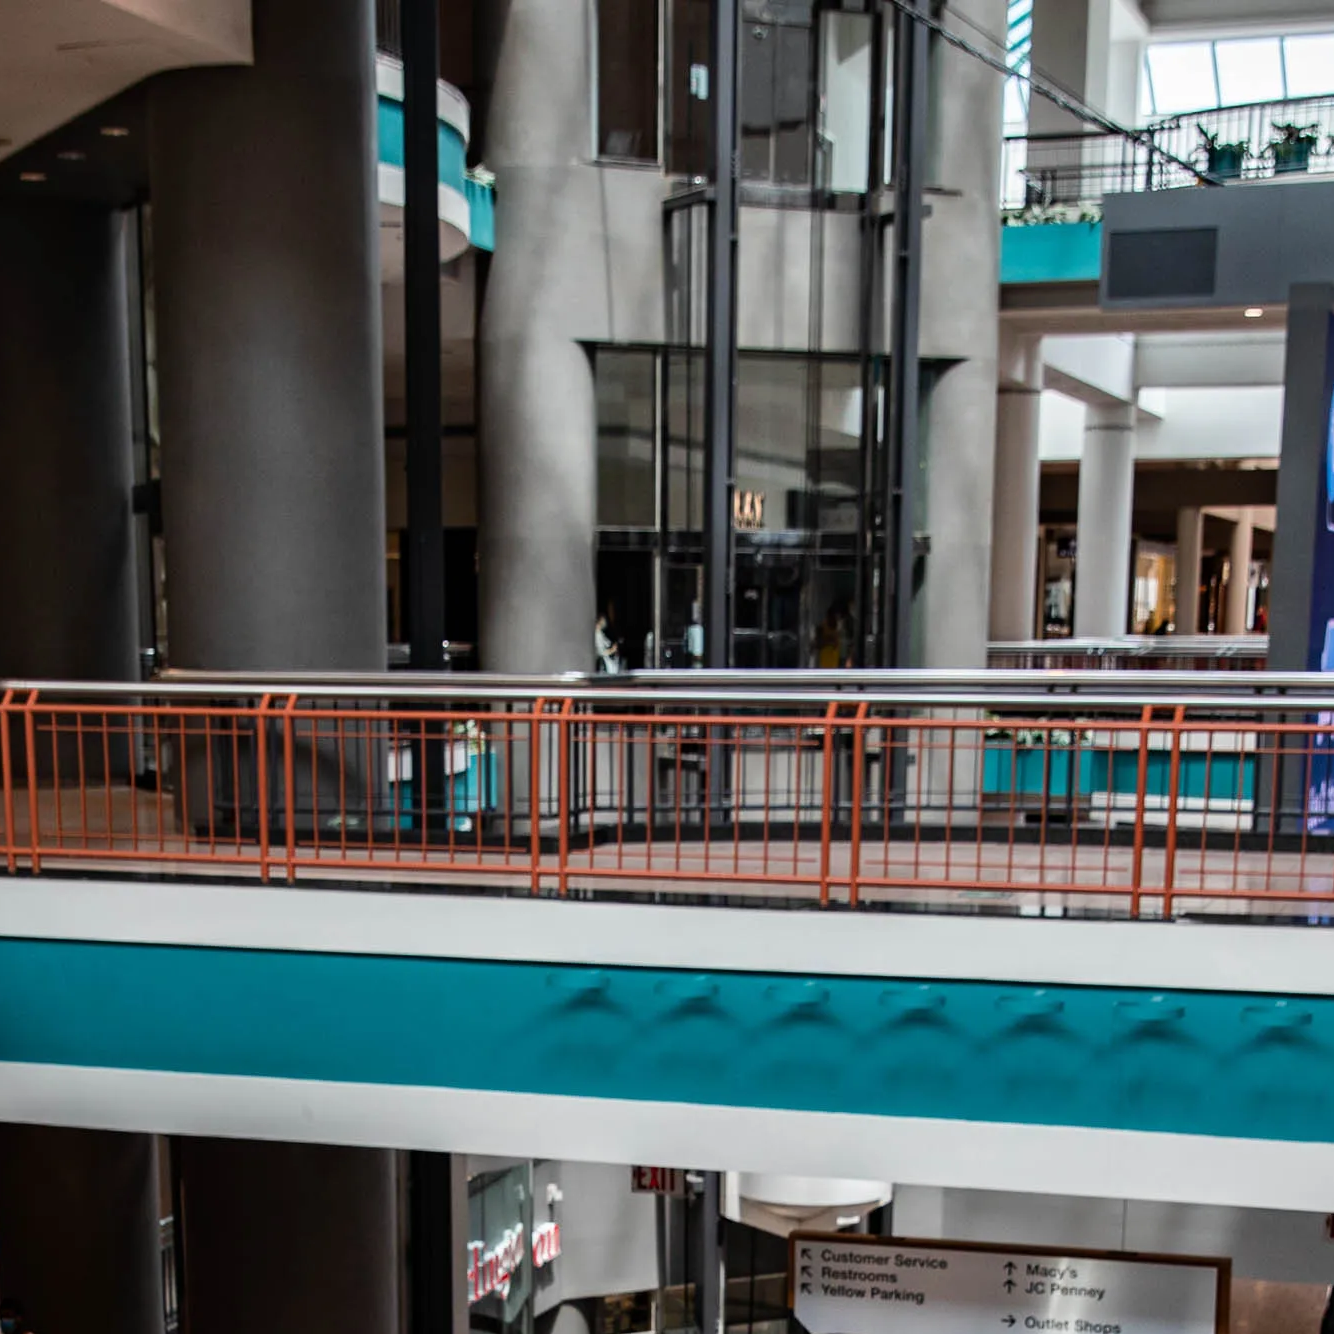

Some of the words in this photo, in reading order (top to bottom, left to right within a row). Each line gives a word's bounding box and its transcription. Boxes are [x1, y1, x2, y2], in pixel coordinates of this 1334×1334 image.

[636, 1166, 676, 1192] EXIT
[821, 1249, 890, 1266] Customer
[894, 1253, 948, 1270] Service
[821, 1267, 898, 1283] Restrooms
[1026, 1263, 1078, 1280] Macy's
[821, 1284, 866, 1299] Yellow
[870, 1286, 925, 1305] Parking
[1025, 1282, 1046, 1295] JC
[1050, 1283, 1105, 1302] Penney
[1024, 1315, 1069, 1331] Outlet
